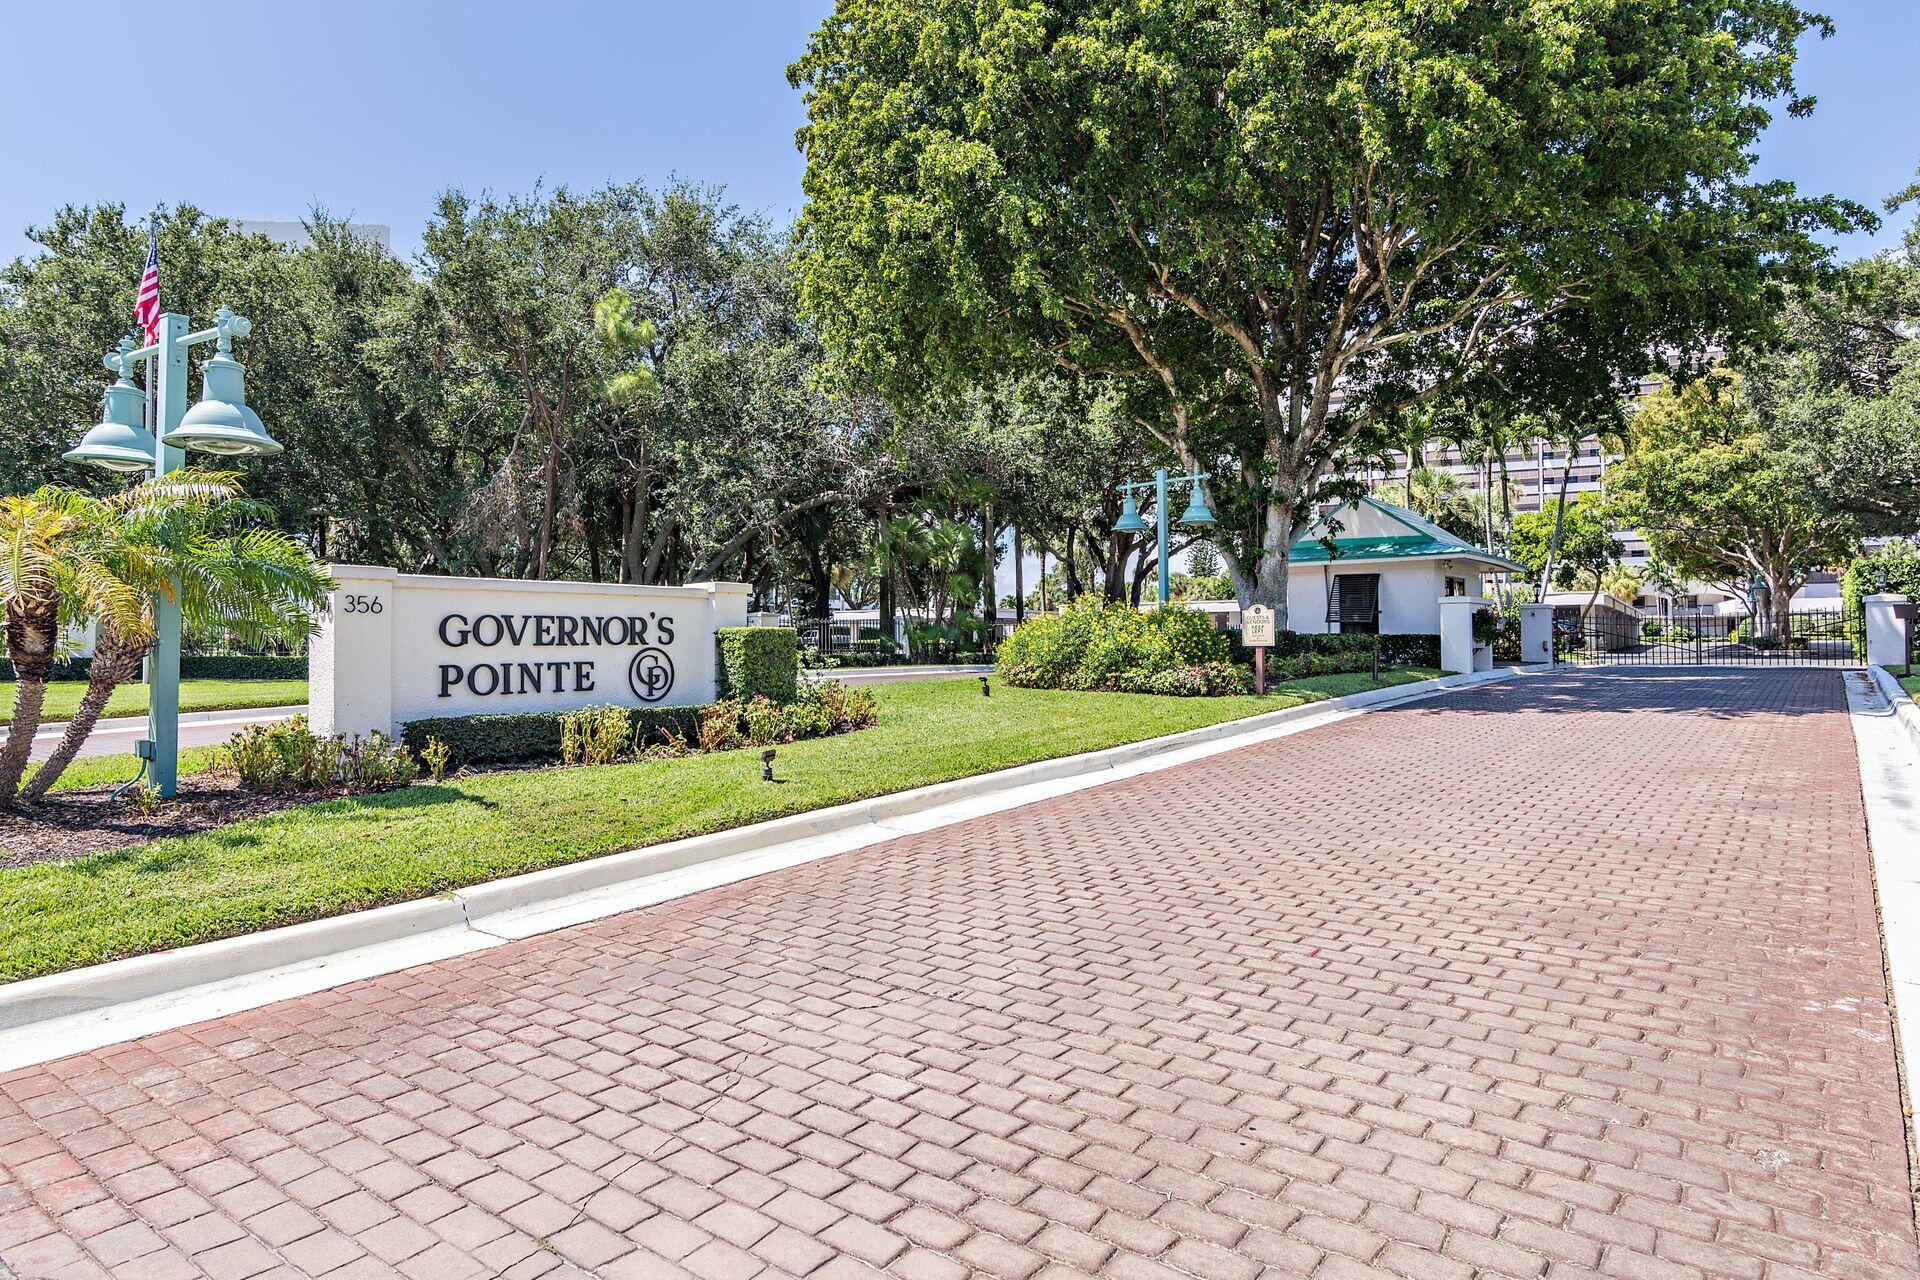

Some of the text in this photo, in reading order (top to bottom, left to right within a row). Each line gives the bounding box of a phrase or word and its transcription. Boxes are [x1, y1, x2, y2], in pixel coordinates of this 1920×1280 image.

[344, 594, 383, 614] 356
[438, 611, 675, 648] GOVERNOR'S
[438, 661, 595, 698] POINTE
